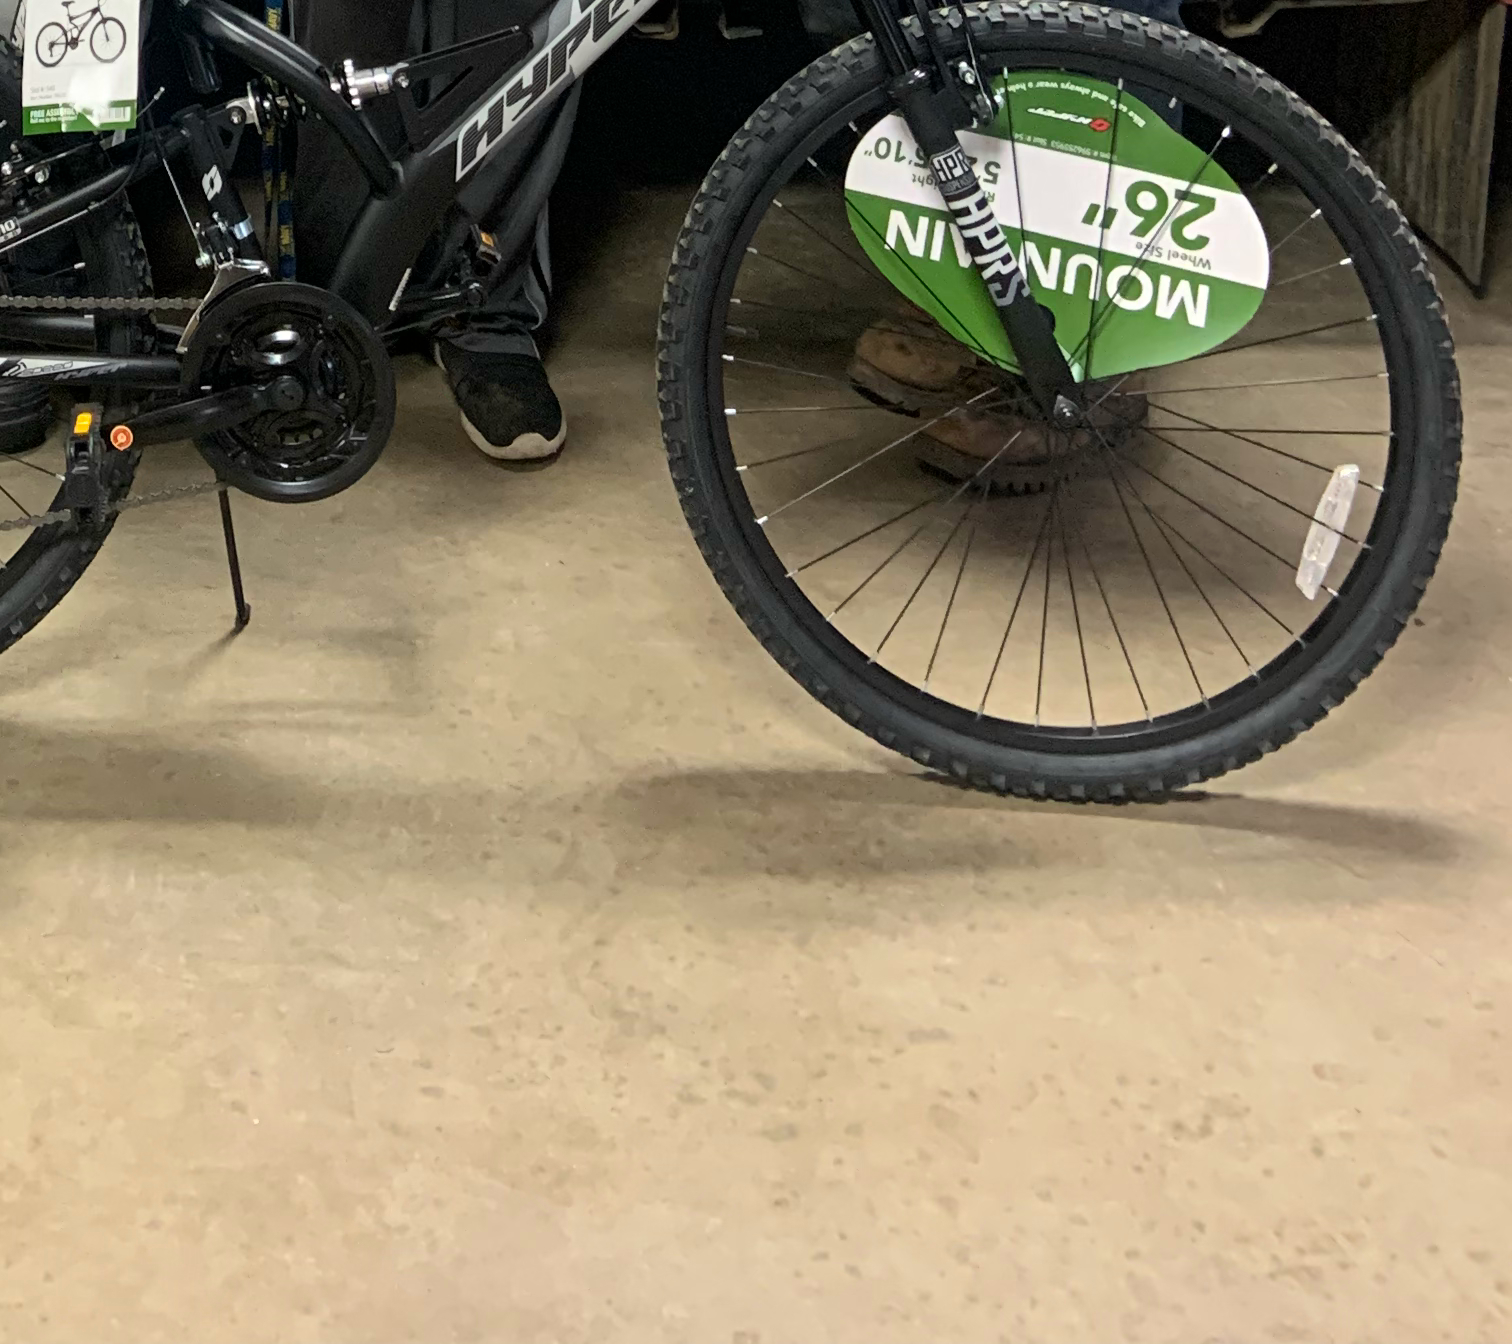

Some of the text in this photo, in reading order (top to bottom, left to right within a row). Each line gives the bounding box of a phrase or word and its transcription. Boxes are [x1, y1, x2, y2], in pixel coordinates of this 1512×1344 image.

[1060, 80, 1091, 95] always
[946, 189, 1031, 307] HPRS
[1166, 248, 1212, 270] Wheel
